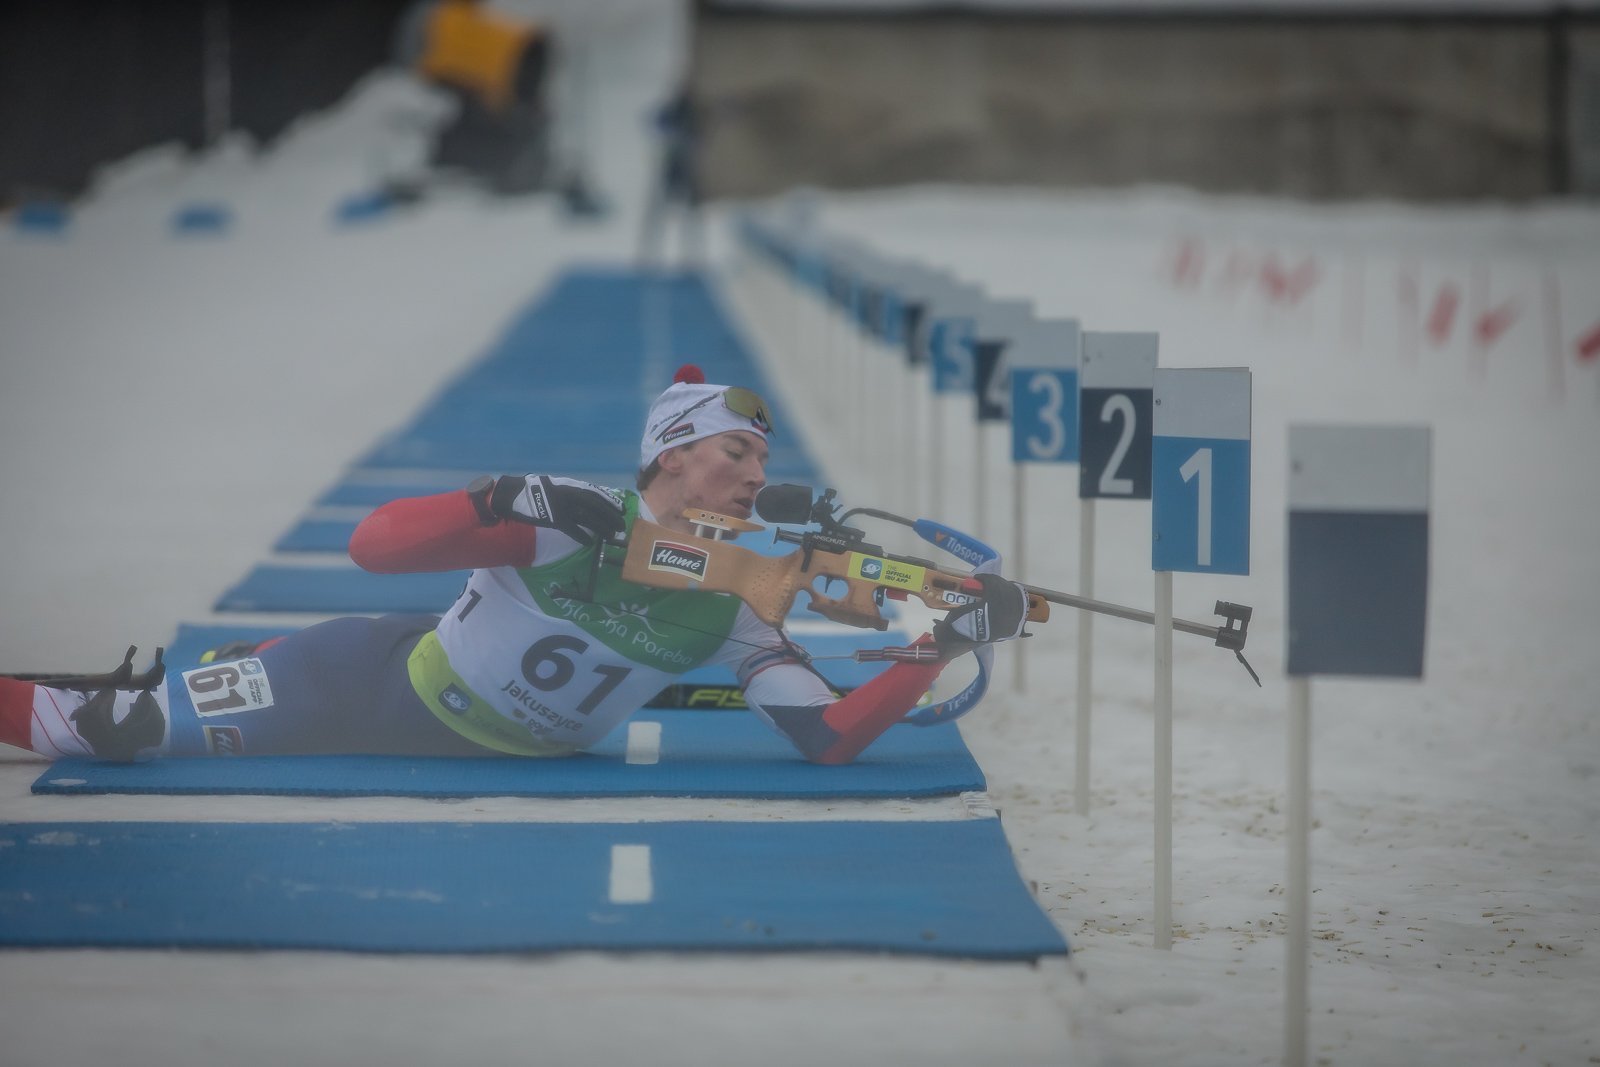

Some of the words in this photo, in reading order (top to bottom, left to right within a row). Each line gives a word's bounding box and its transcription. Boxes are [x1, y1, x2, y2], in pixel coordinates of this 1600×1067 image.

[1026, 374, 1066, 458] 3
[1099, 393, 1137, 495] 2
[1179, 447, 1213, 567] 1
[655, 549, 702, 571] Hamé
[886, 569, 912, 580] OFFICIAL
[946, 536, 985, 565] Tipsport
[188, 666, 248, 713] 61
[521, 634, 633, 716] 61
[688, 689, 748, 707] FIS
[501, 679, 584, 732] Jakuszyce
